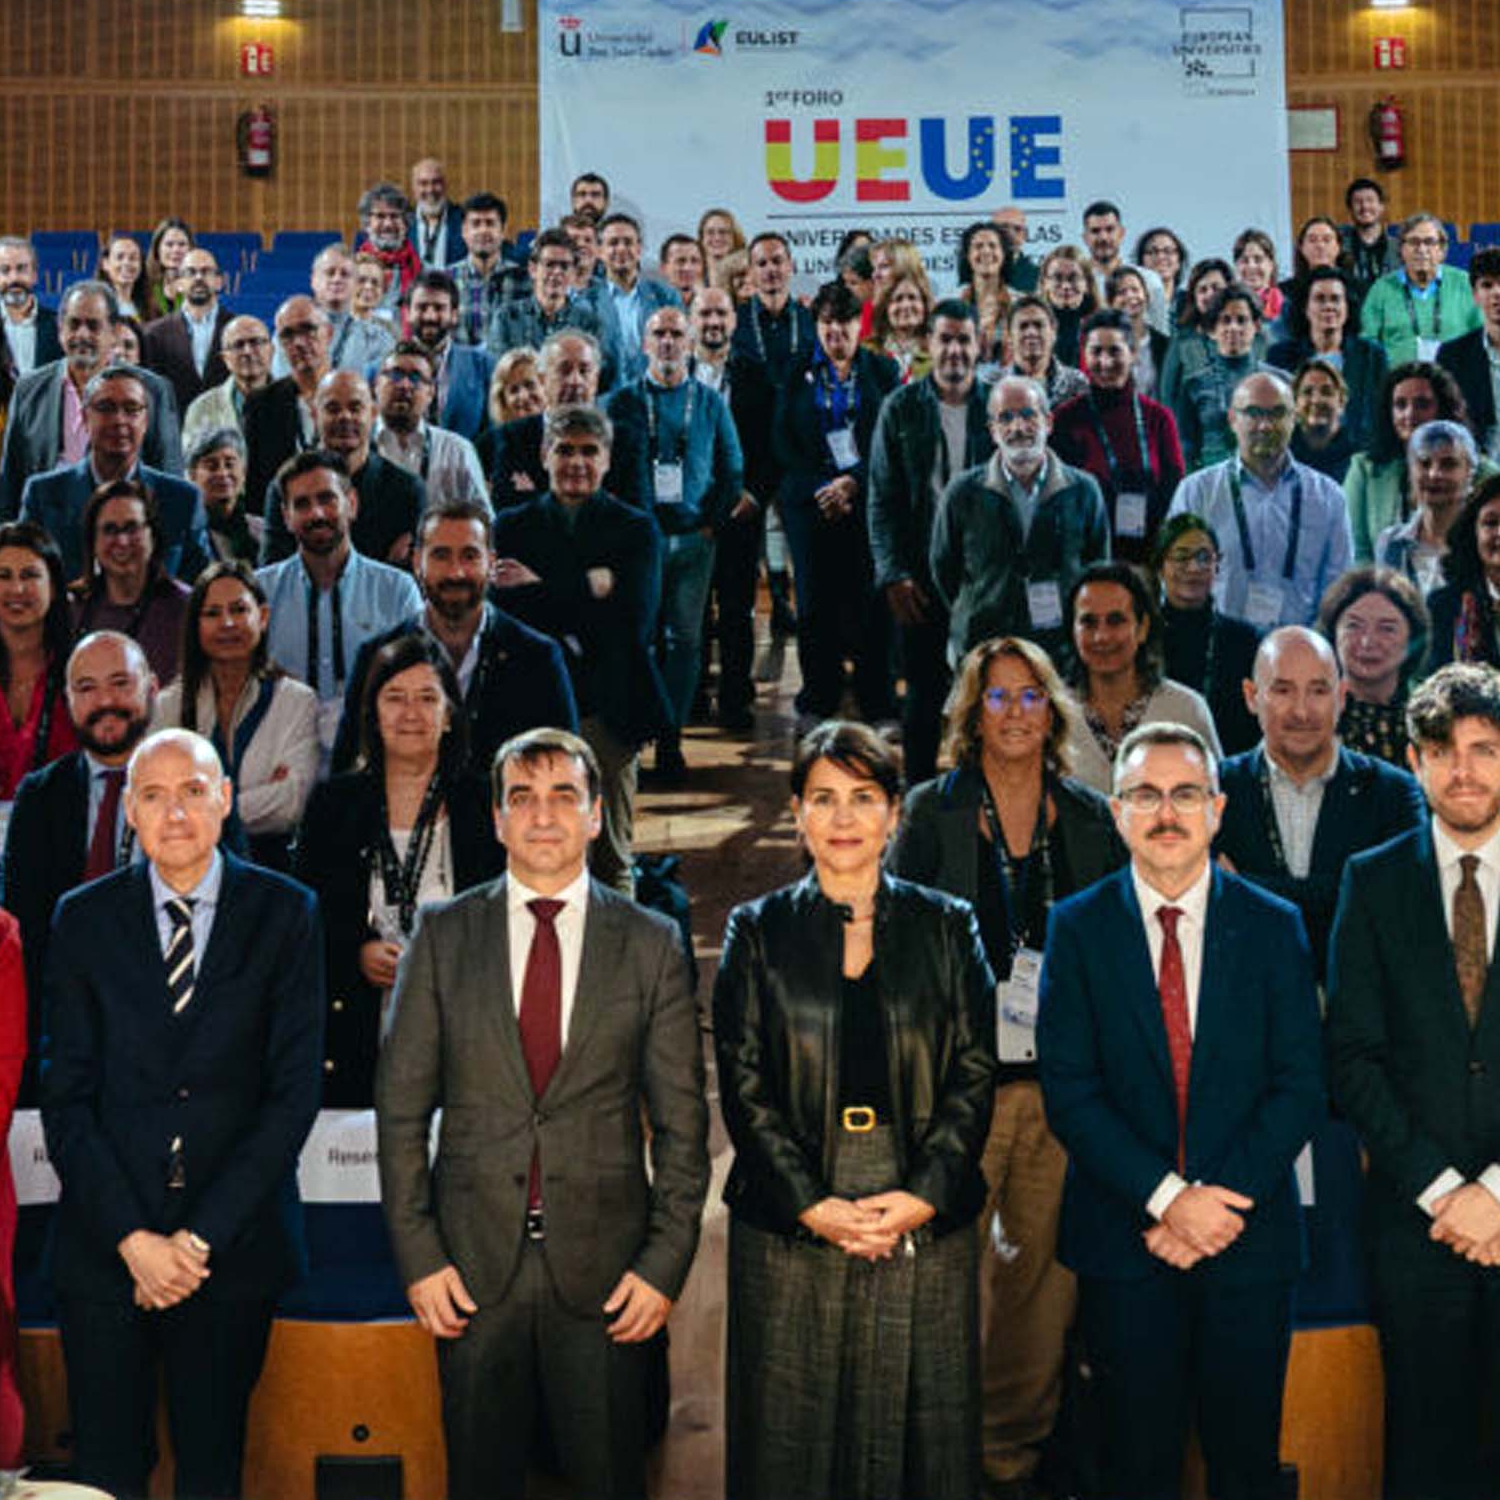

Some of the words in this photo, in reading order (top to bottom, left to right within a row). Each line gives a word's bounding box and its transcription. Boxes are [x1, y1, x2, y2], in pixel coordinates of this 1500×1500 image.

[735, 30, 799, 45] EULIST
[793, 89, 844, 108] FORO
[764, 115, 1066, 203] UEUE
[784, 226, 935, 246] NIVERDADES
